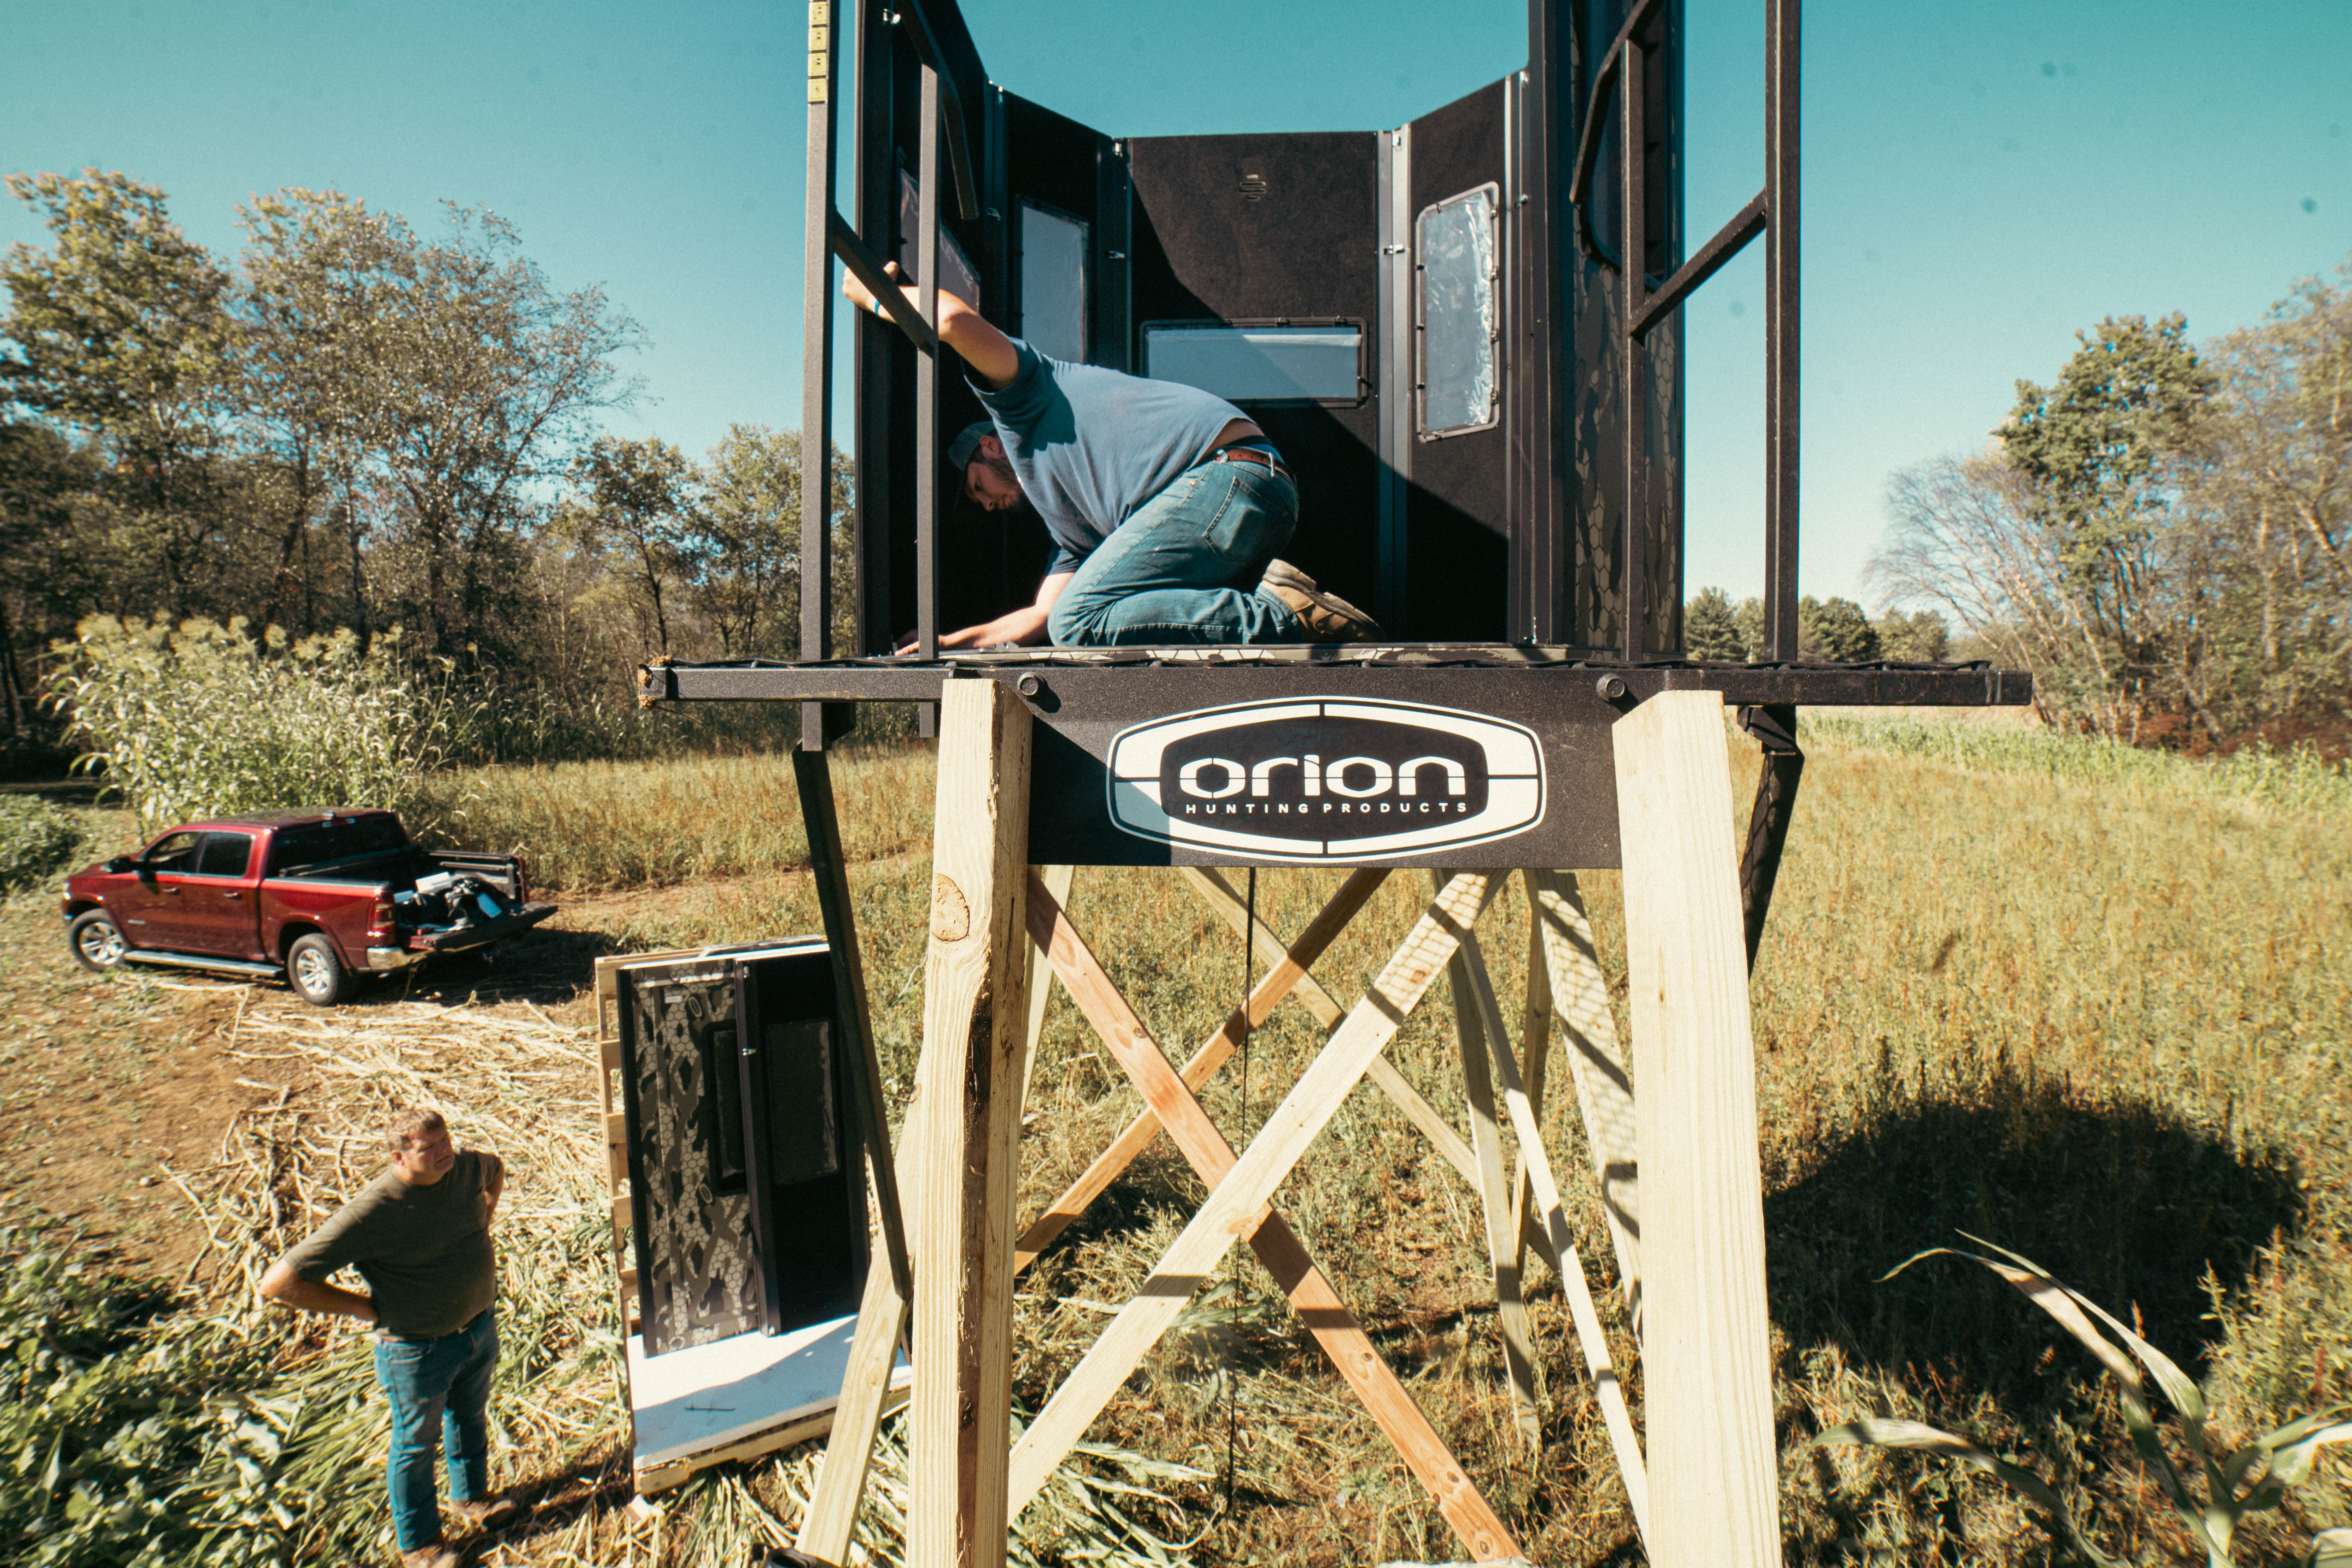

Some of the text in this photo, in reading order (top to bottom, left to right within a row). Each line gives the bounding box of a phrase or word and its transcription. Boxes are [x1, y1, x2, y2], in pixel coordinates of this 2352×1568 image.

[1180, 754, 1466, 799] orion
[1186, 802, 1467, 814] HUNTING PRODUCTS
